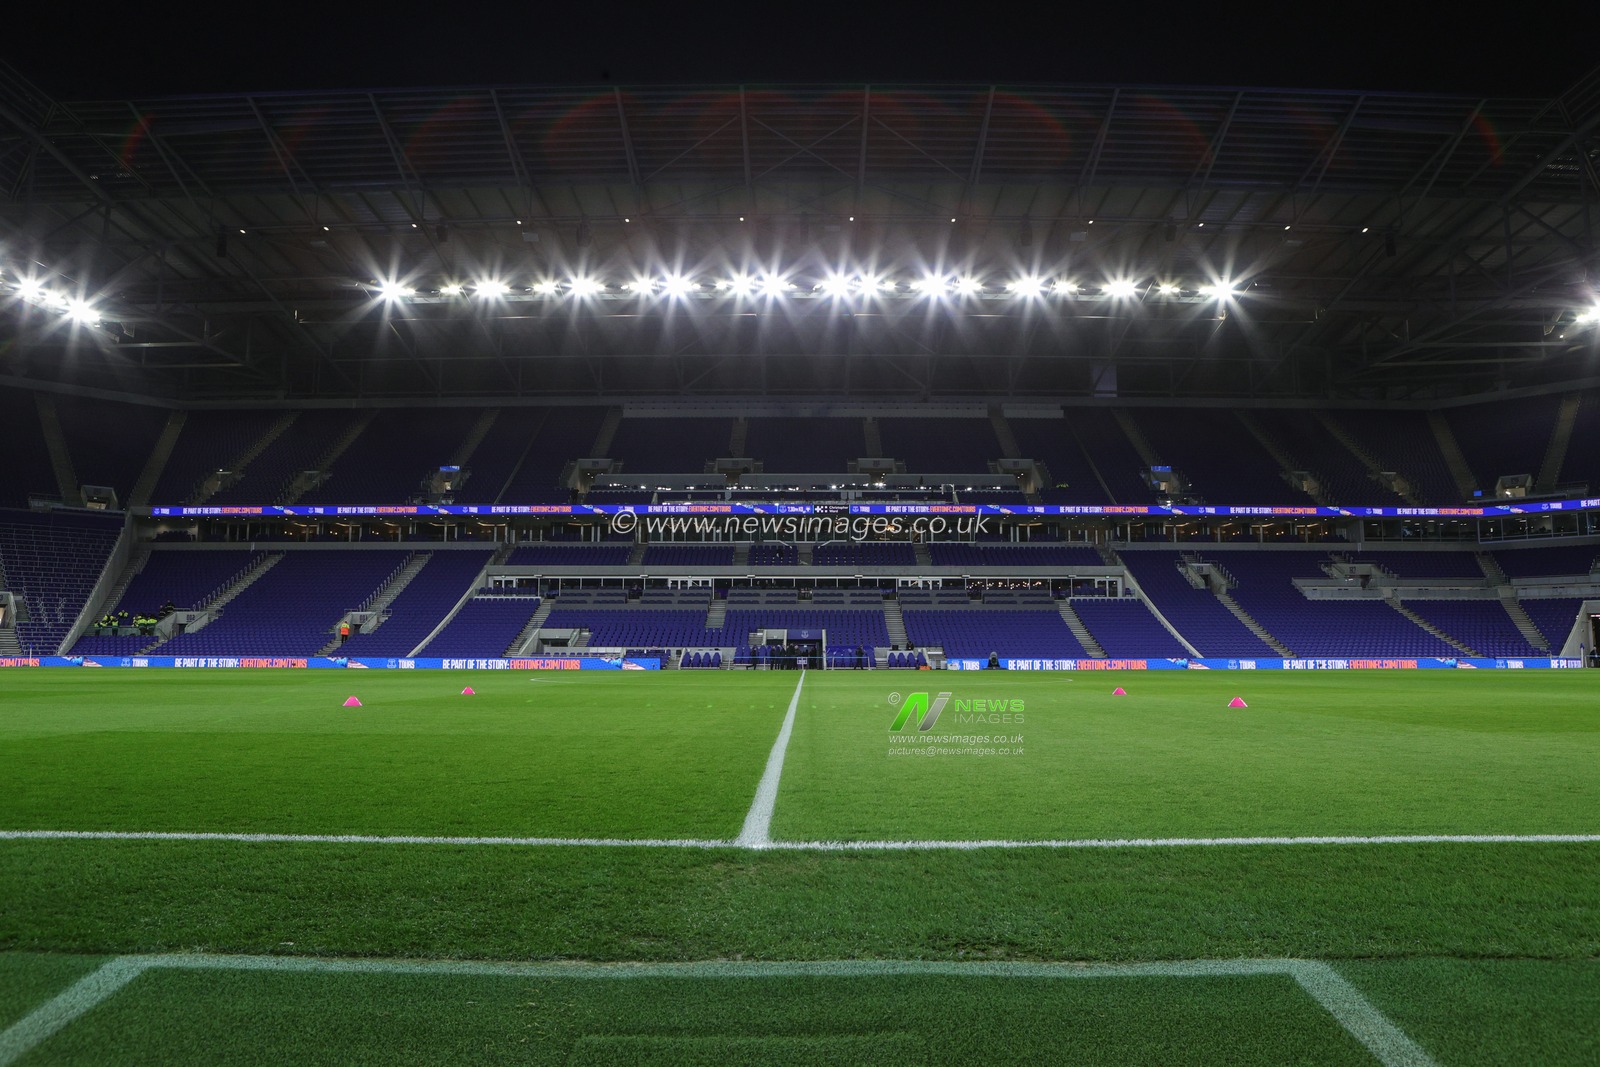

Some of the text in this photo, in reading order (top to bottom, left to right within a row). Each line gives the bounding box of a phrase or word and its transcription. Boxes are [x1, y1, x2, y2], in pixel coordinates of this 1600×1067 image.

[132, 658, 148, 667] TOURS
[182, 658, 197, 668] PART
[208, 658, 217, 668] THE
[218, 658, 239, 668] STORY:
[398, 660, 414, 668] TOURS
[450, 659, 466, 669] PART
[476, 659, 486, 669] THE
[488, 659, 509, 669] STORY:
[963, 660, 980, 670] TOURS
[1016, 660, 1032, 670] PART
[1042, 660, 1053, 670] THE
[1054, 660, 1076, 670] STORY:
[1240, 660, 1256, 669] TOURS
[1291, 660, 1306, 669] PART
[1316, 660, 1326, 669] THE
[1328, 660, 1349, 669] STORY:
